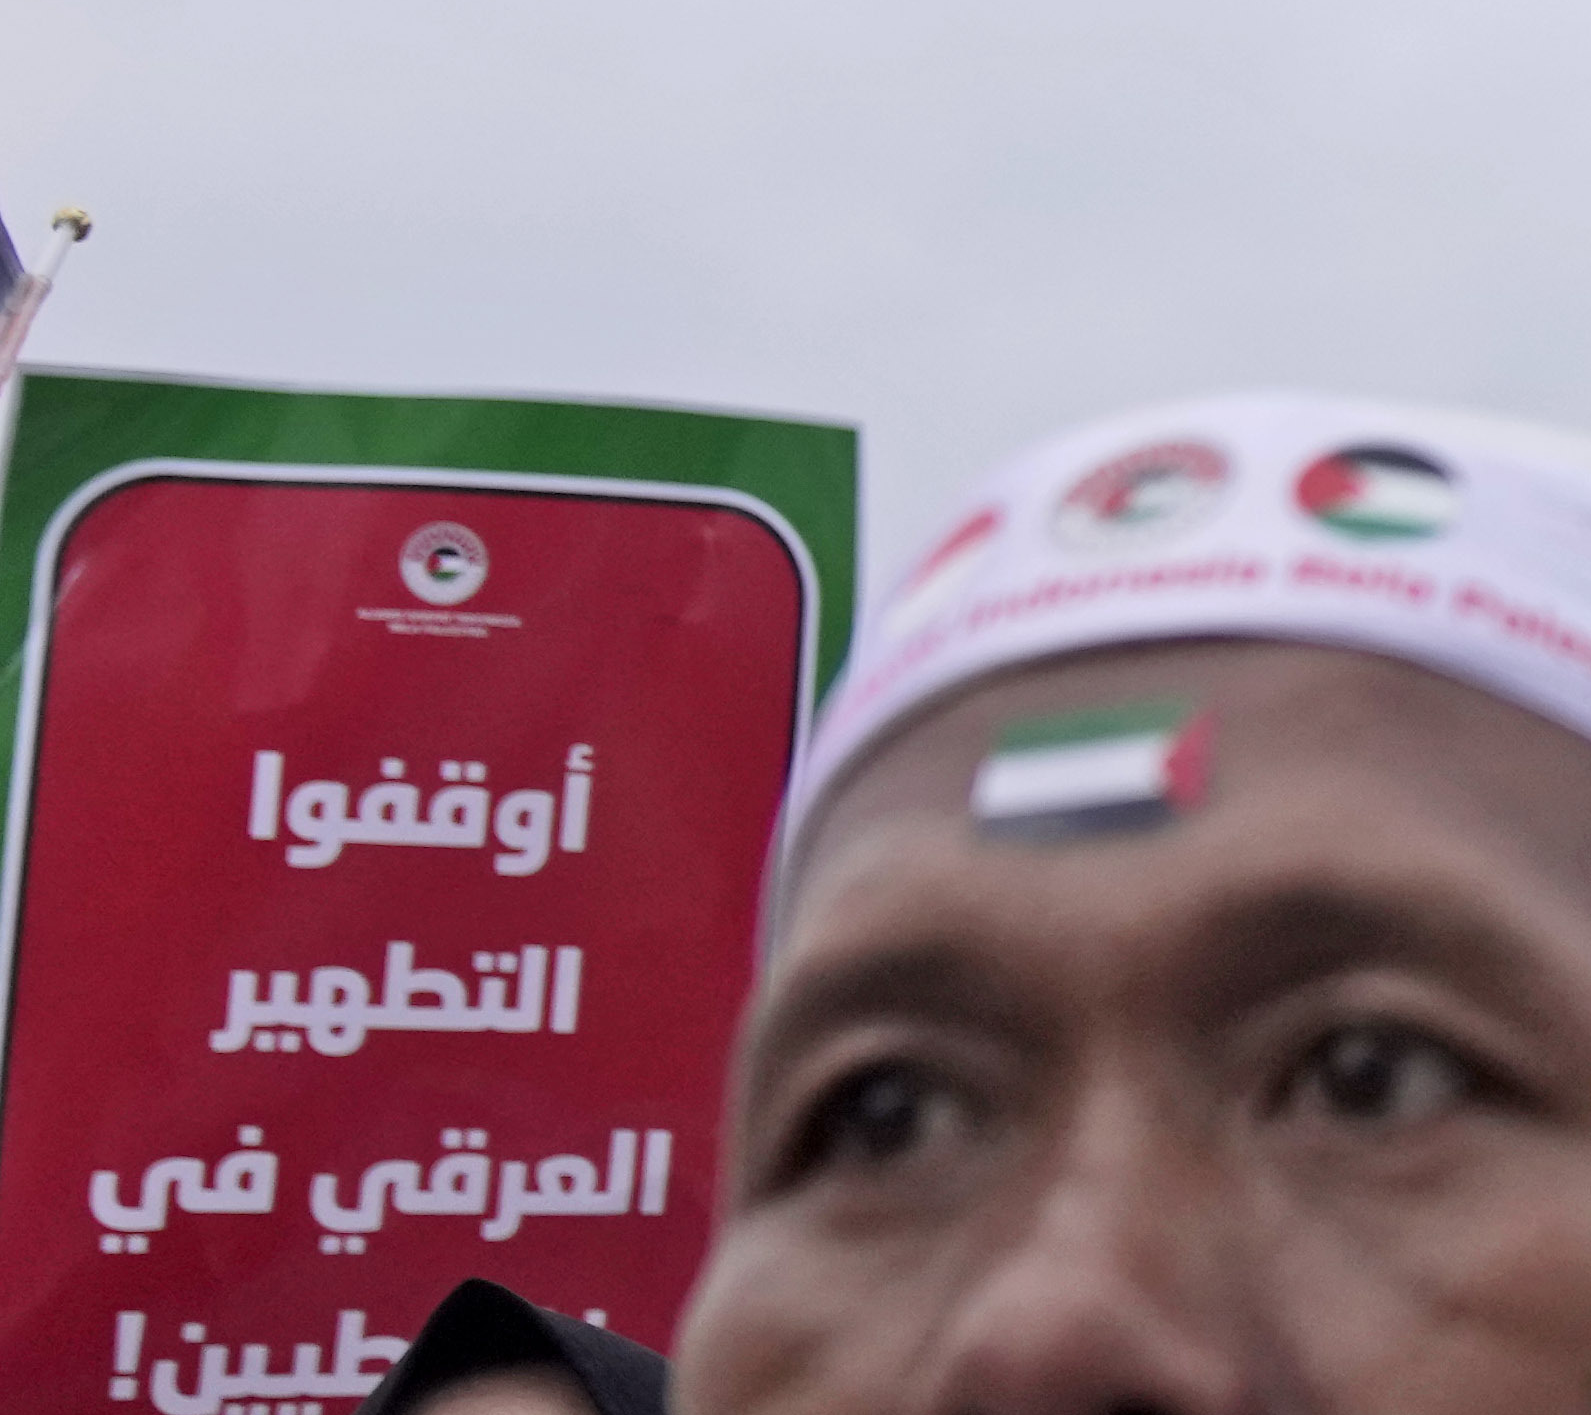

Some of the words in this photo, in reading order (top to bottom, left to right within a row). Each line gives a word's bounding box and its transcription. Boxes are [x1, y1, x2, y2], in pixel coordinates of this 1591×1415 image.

[248, 745, 594, 875] أوقفوا
[210, 942, 582, 1056] التطهير
[89, 1124, 278, 1256] في
[309, 1127, 673, 1256] العرقي
